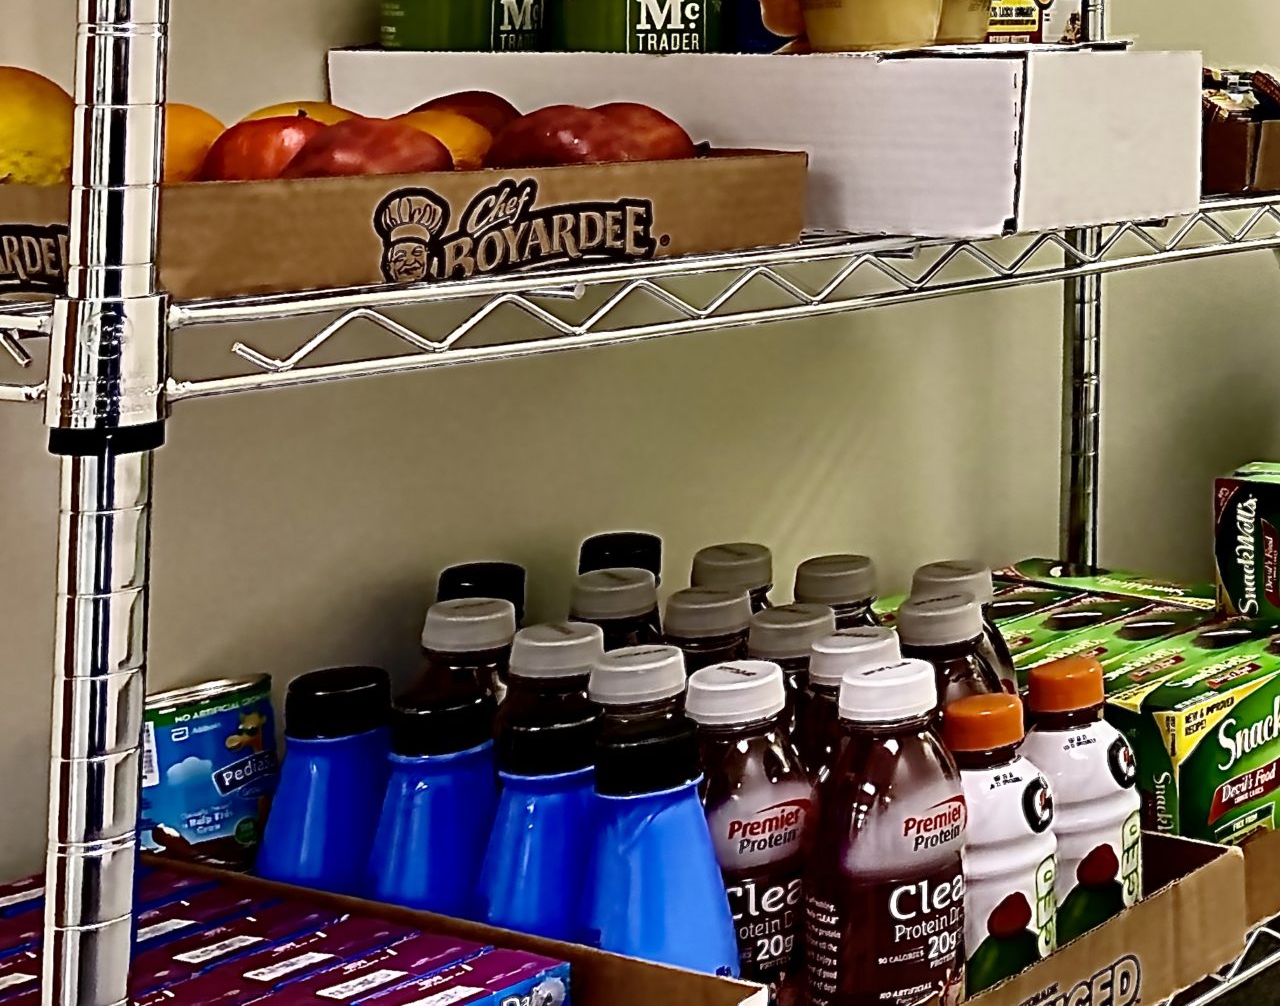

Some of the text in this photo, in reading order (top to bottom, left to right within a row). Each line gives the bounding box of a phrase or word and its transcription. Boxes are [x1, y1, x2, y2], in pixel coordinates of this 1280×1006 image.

[636, 32, 700, 52] TRADER
[466, 185, 531, 235] Chef
[443, 205, 649, 278] BOYARDEE
[1237, 496, 1259, 614] SnackWell's
[174, 712, 190, 724] NO
[1221, 761, 1277, 803] Devil's Food
[727, 806, 801, 841] Premier
[902, 804, 963, 839] Premier
[738, 828, 798, 855] Protein
[912, 824, 961, 852] Protein
[739, 917, 781, 940] otein
[894, 913, 948, 943] Protein
[756, 934, 795, 962] 20g
[888, 948, 925, 964] CALORIES
[927, 930, 958, 960] 20g
